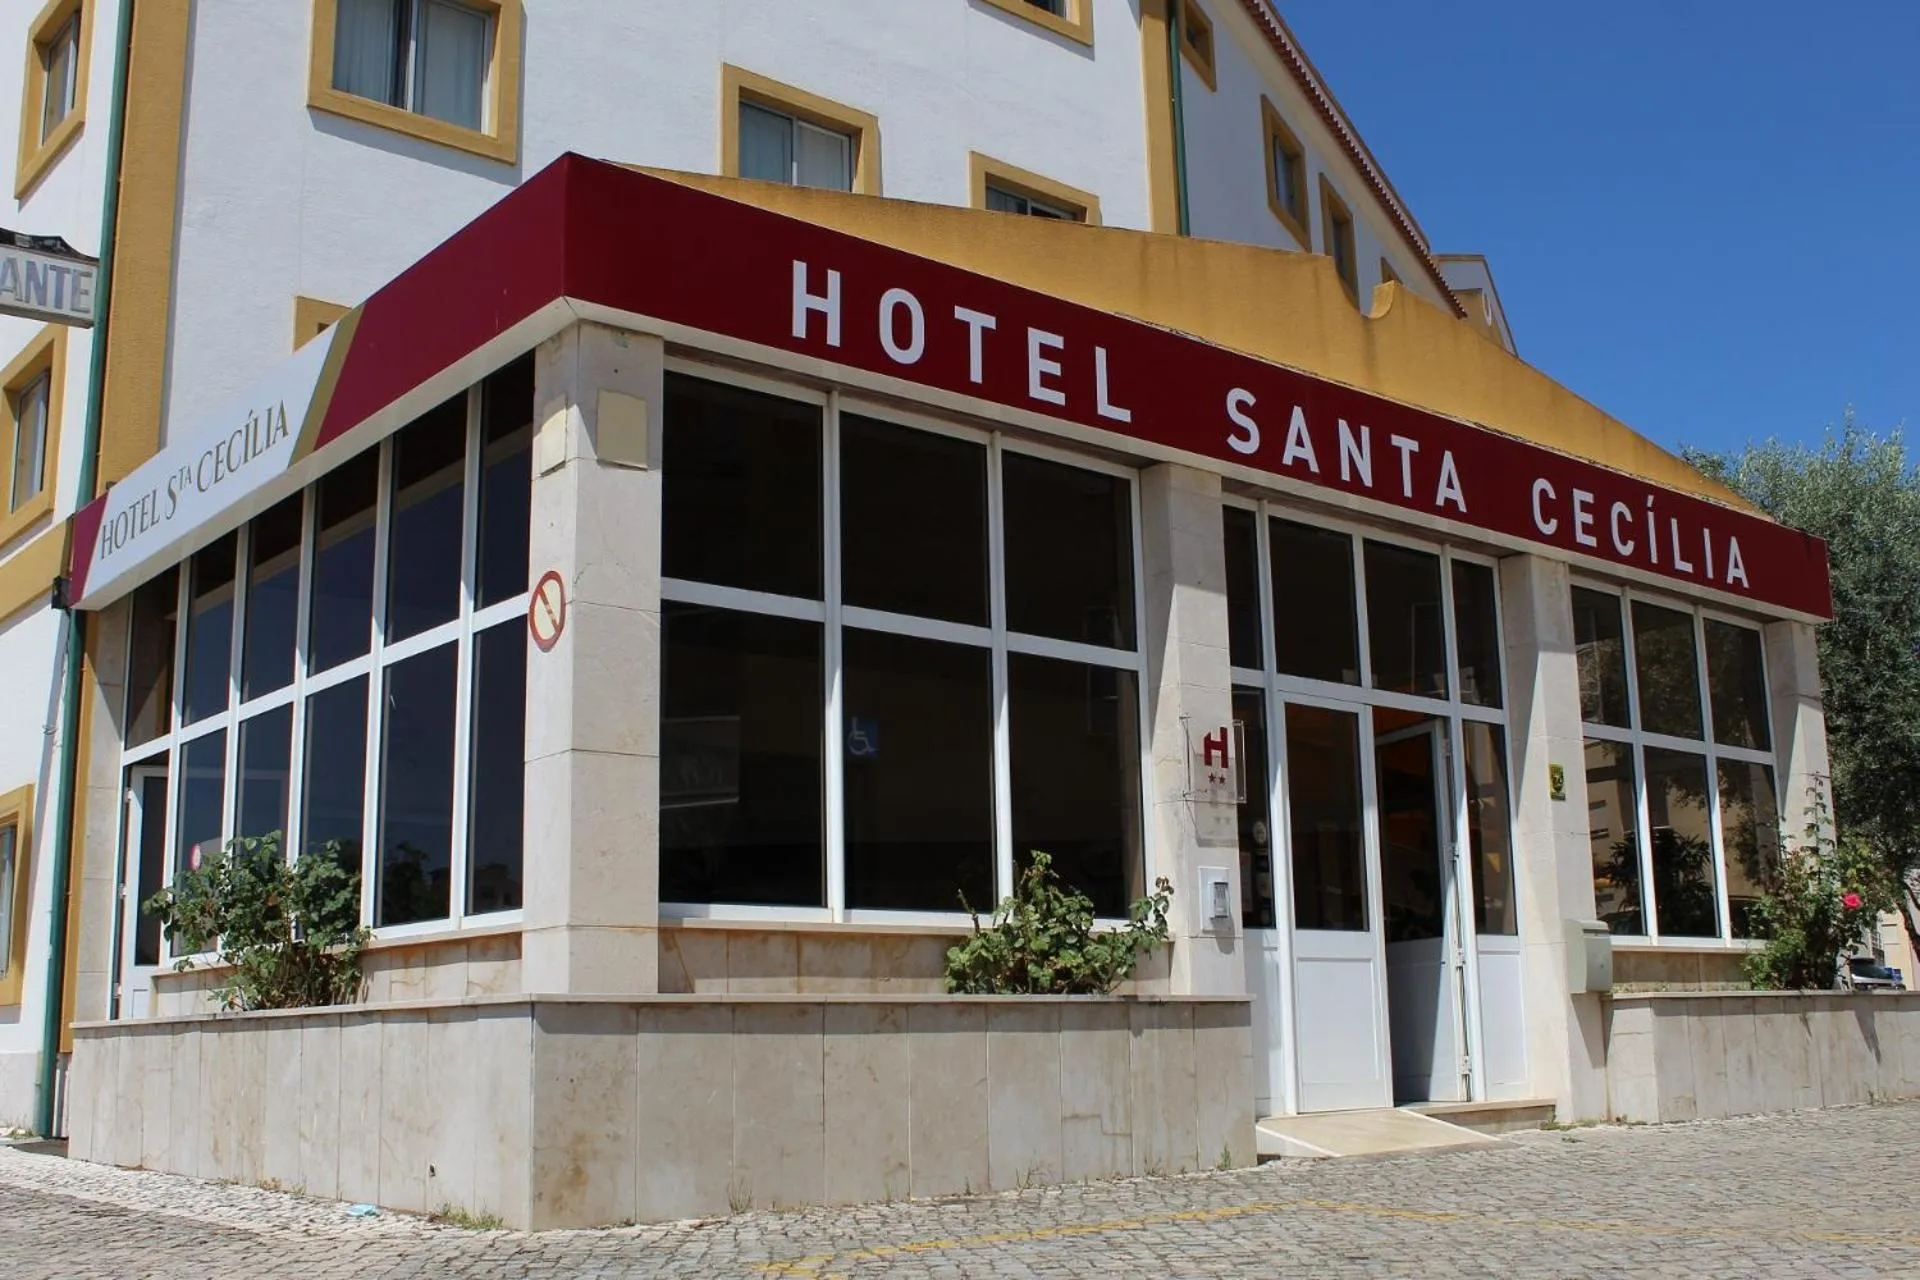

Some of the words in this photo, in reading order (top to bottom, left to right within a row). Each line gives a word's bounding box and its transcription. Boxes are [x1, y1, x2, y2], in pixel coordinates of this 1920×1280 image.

[0, 257, 93, 313] ANTE
[792, 259, 1132, 423] HOTEL
[1225, 387, 1467, 513] SANTA
[1531, 476, 1749, 589] CECÍLIA
[100, 488, 161, 560] HOTEL
[196, 399, 290, 493] CECÍLIA
[1203, 726, 1229, 769] H
